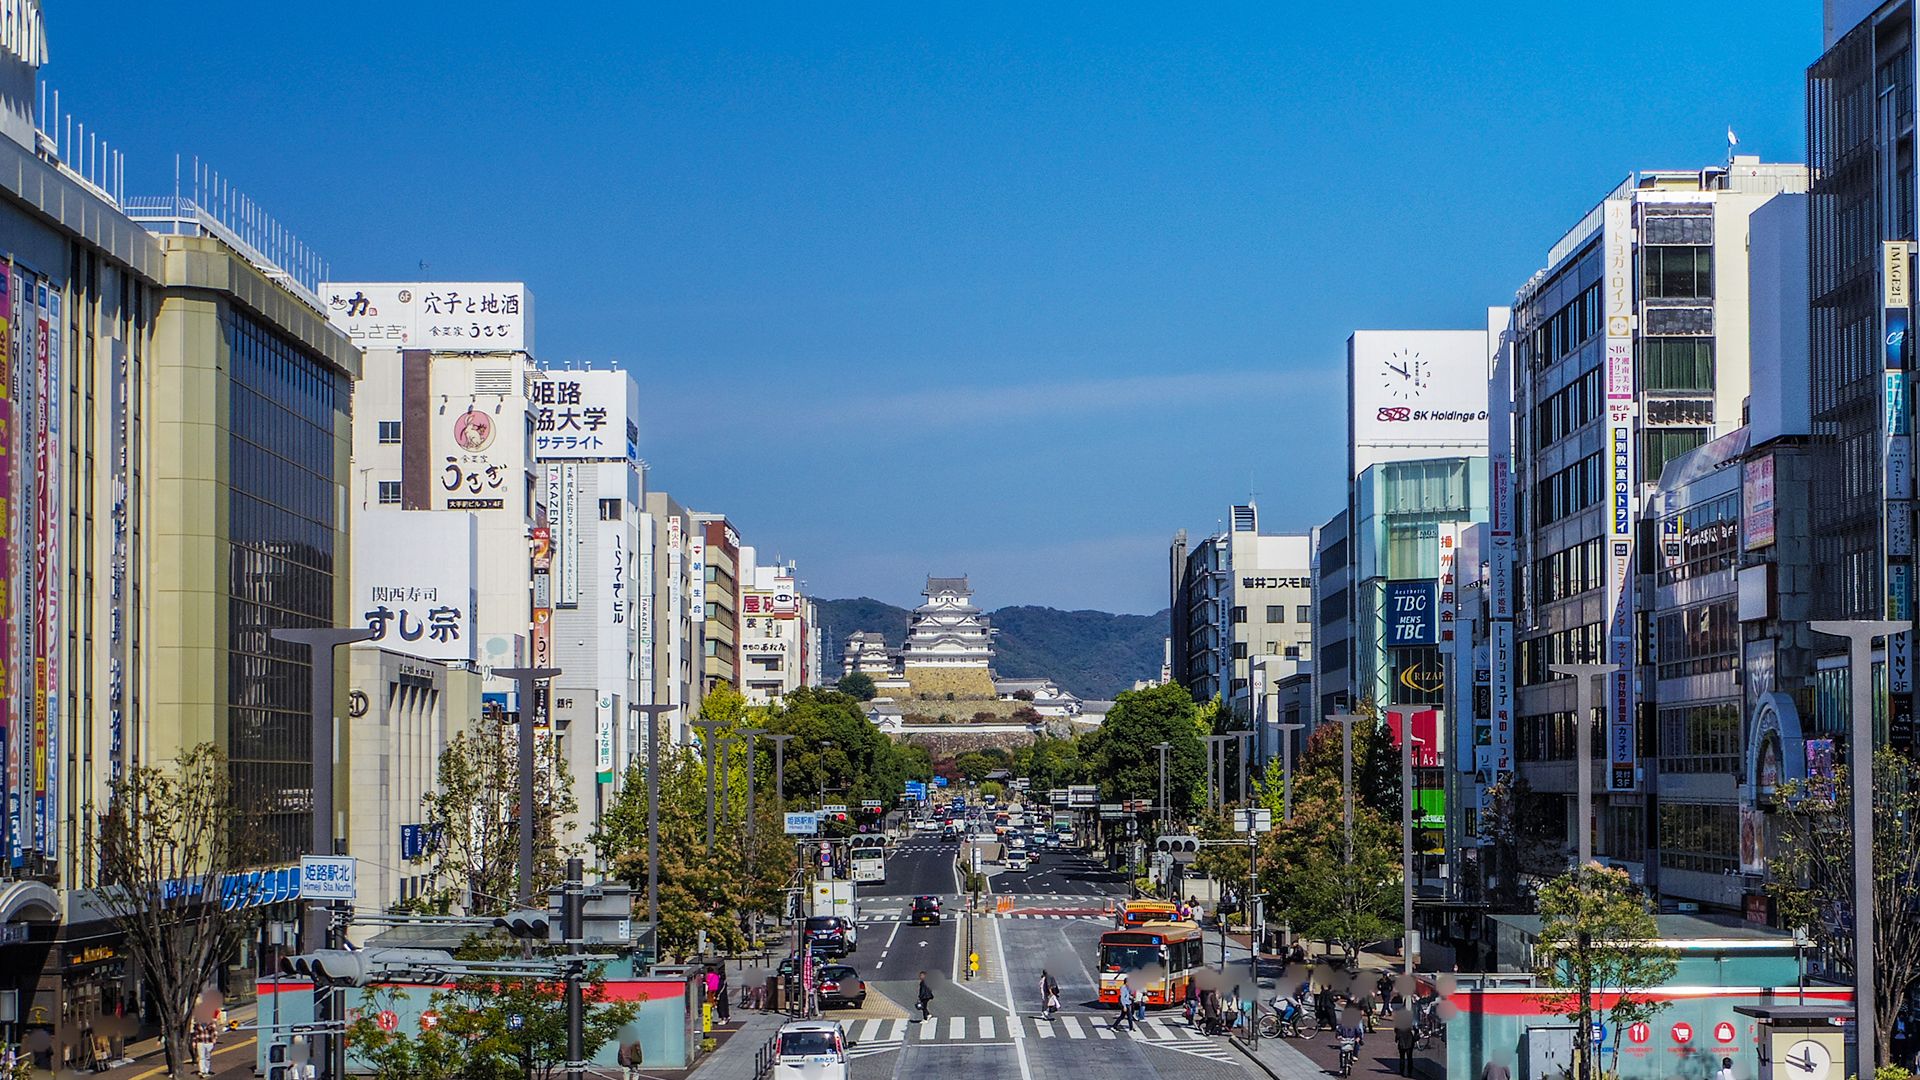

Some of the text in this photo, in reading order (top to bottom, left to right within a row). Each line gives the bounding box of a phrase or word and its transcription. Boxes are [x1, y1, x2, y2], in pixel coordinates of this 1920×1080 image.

[424, 292, 519, 315] 穴子と地酒
[469, 323, 511, 338] うさぎ
[533, 381, 582, 405] 姫路
[1413, 411, 1427, 420] SK
[1430, 411, 1475, 422] Holdings
[1612, 413, 1627, 421] 5F
[537, 436, 603, 449] サテライト
[441, 456, 507, 494] うさぎ
[1615, 429, 1627, 533] 個別教室のトライ
[550, 466, 559, 525] TAKAZEN
[372, 587, 437, 602] 関西寿司
[1440, 536, 1454, 641] 播州信用金庫
[1394, 595, 1426, 611] TBC
[364, 606, 462, 643] すし宗
[1396, 624, 1425, 640] TBC
[1894, 682, 1907, 691] 3F
[601, 722, 610, 765] りそな銀行
[1618, 727, 1626, 761] カラオケ
[305, 864, 350, 881] 姫路駅北
